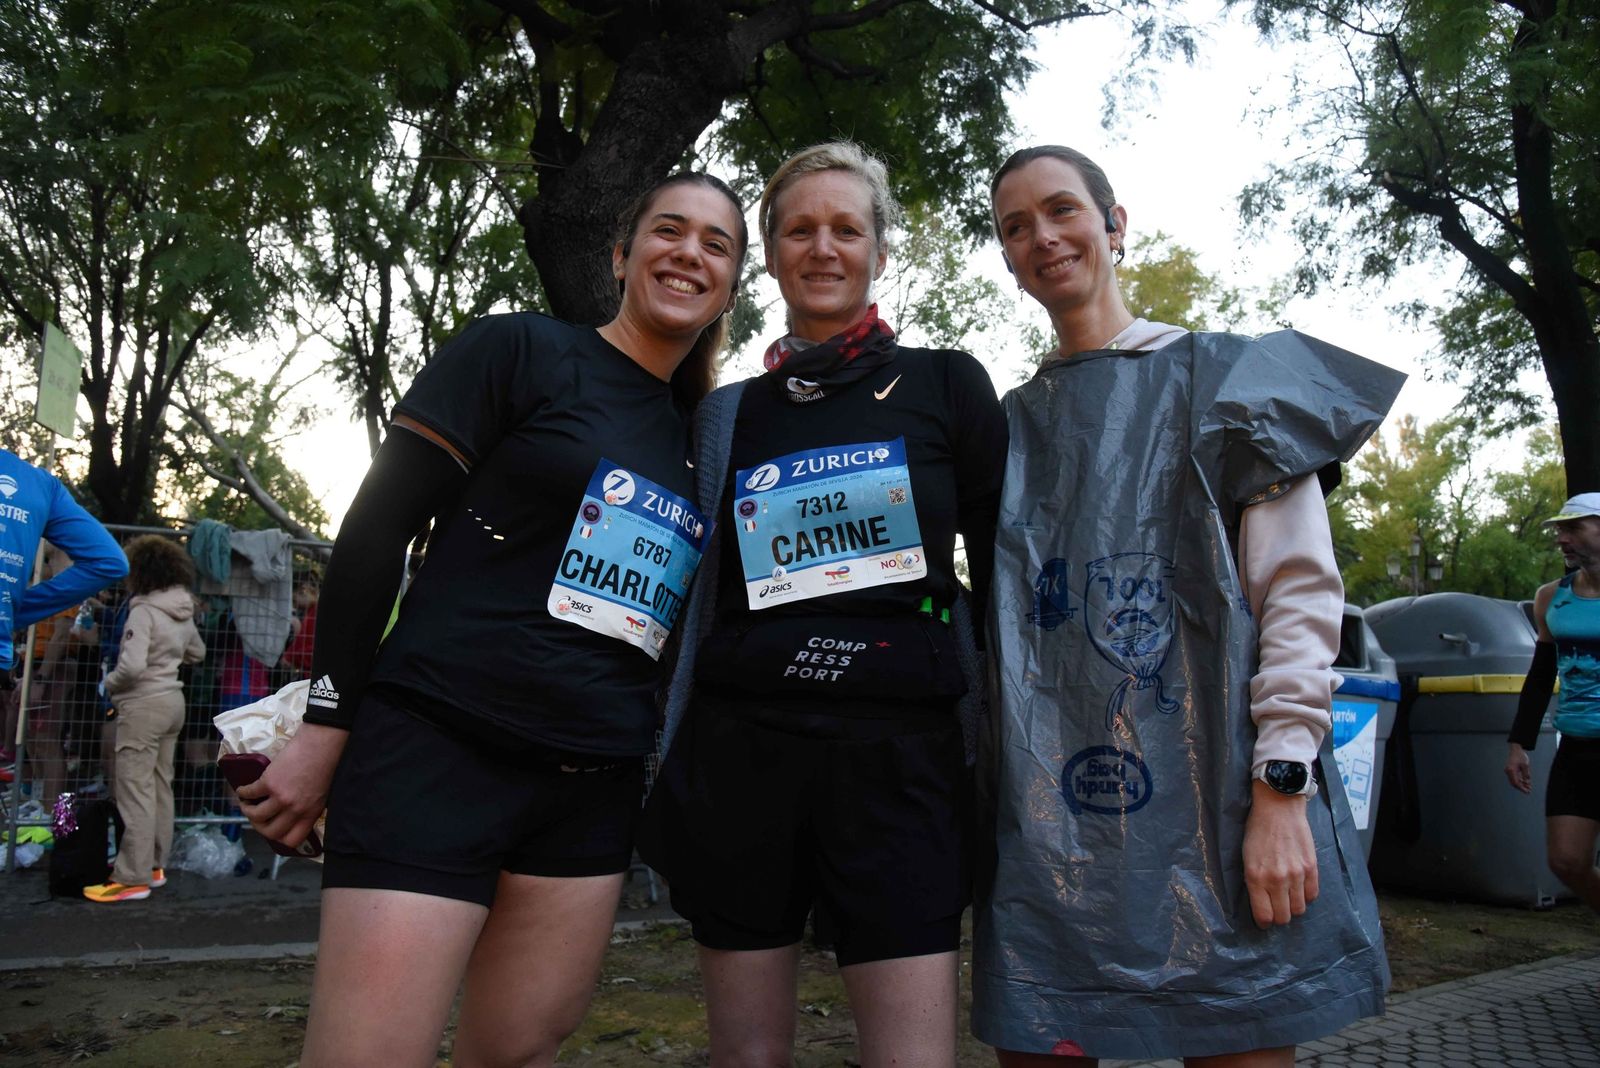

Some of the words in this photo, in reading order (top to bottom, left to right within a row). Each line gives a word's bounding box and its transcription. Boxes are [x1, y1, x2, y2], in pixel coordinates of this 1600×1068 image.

[791, 450, 885, 478] ZURICH
[642, 490, 702, 539] ZURICH
[796, 491, 848, 519] 7312
[633, 536, 672, 569] 6787
[771, 515, 890, 567] CARINE
[560, 548, 682, 625] CHARLOTTE
[770, 582, 792, 594] asics
[807, 637, 867, 652] COMP
[794, 650, 852, 667] RESS
[783, 665, 844, 682] PORT
[309, 688, 340, 700] adidas
[1086, 759, 1127, 780] bag
[1074, 776, 1139, 799] handy
